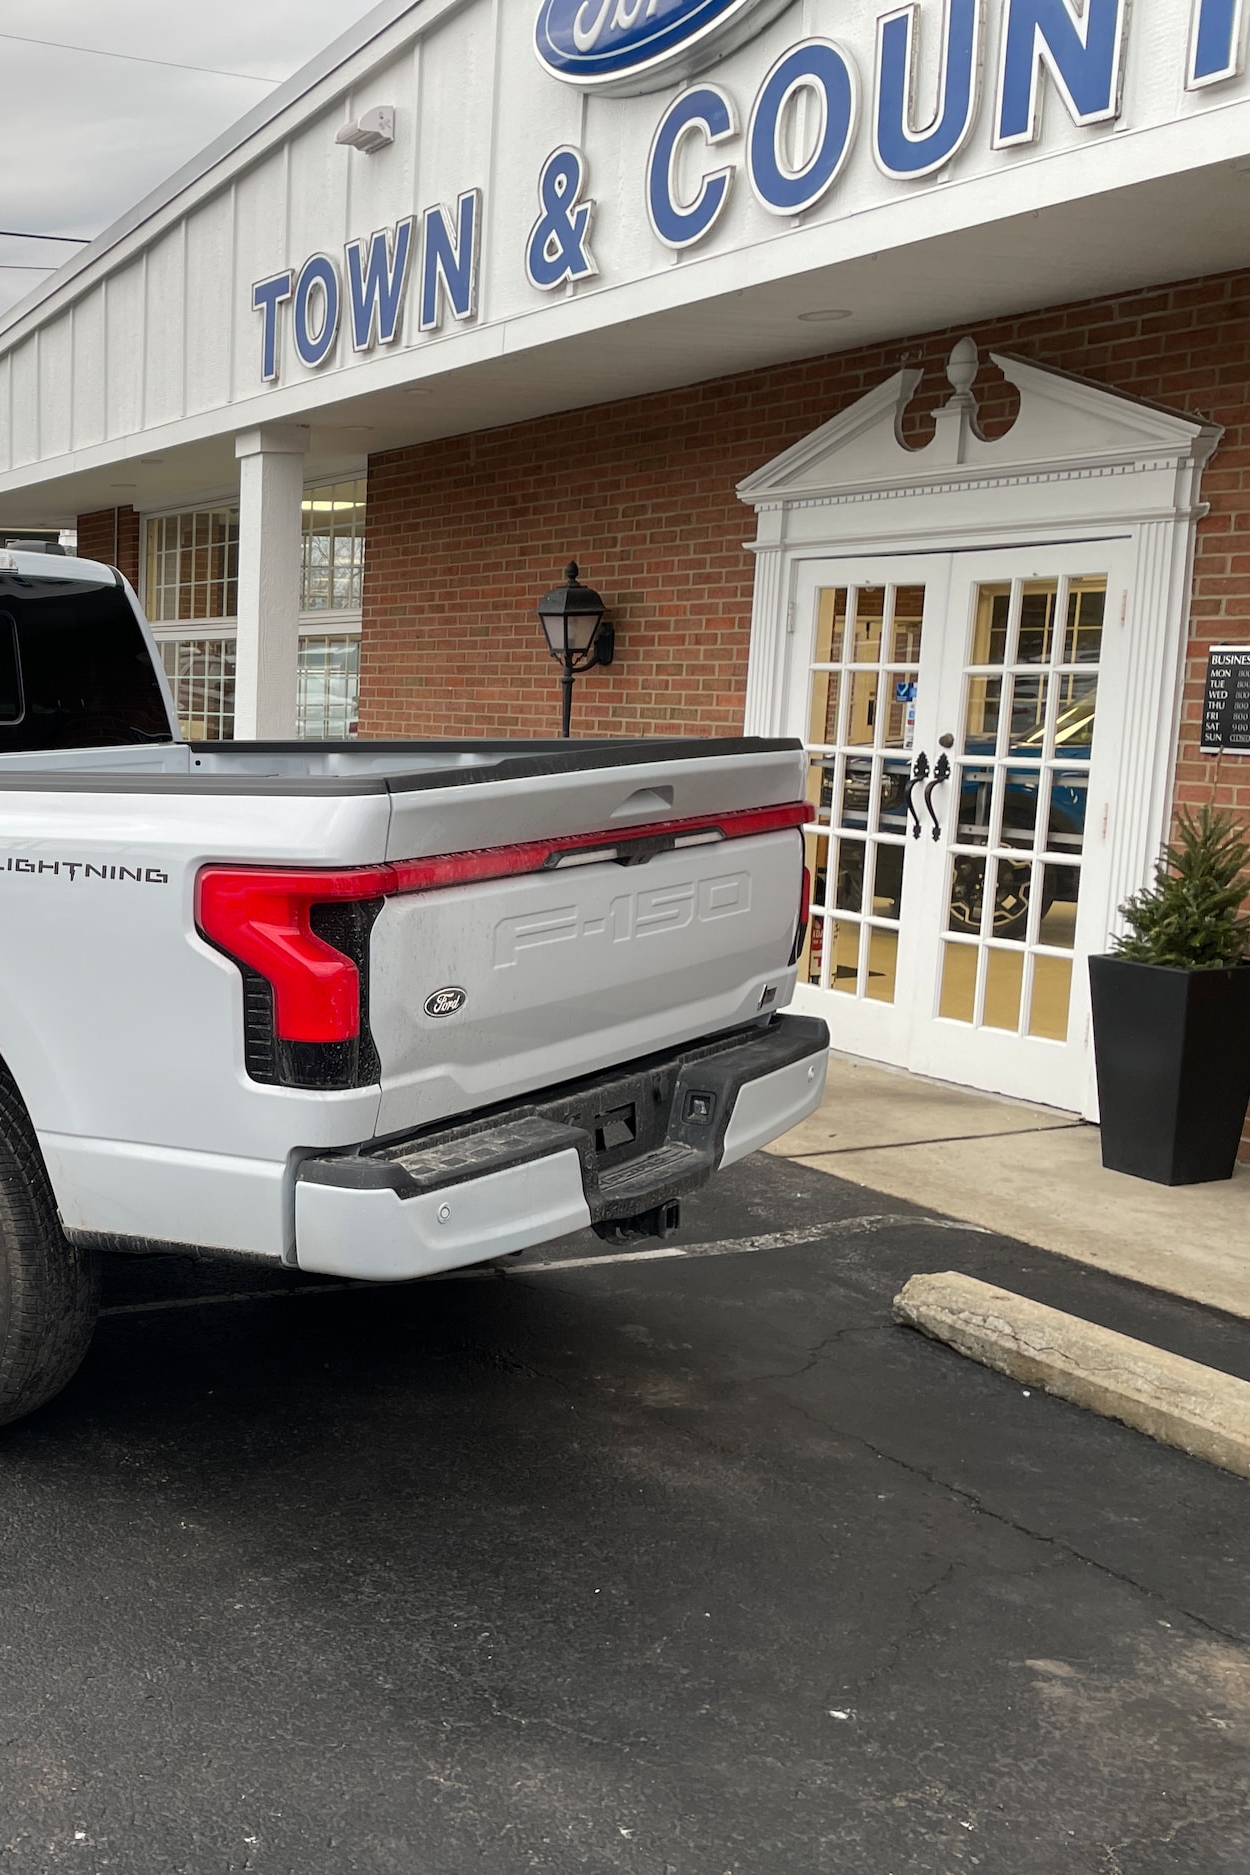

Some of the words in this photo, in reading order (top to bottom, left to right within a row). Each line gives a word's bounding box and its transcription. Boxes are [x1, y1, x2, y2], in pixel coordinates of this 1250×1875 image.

[252, 187, 481, 383] TOWN
[525, 145, 599, 291] &
[1210, 669, 1232, 678] MON
[1210, 680, 1226, 688] TUE
[1209, 690, 1229, 699] WED
[1208, 701, 1226, 710] THU
[1206, 711, 1219, 720] FRI
[1205, 722, 1221, 731] SAT
[1204, 733, 1223, 742] SUN
[493, 870, 752, 970] F-150
[433, 992, 461, 1013] Ford
